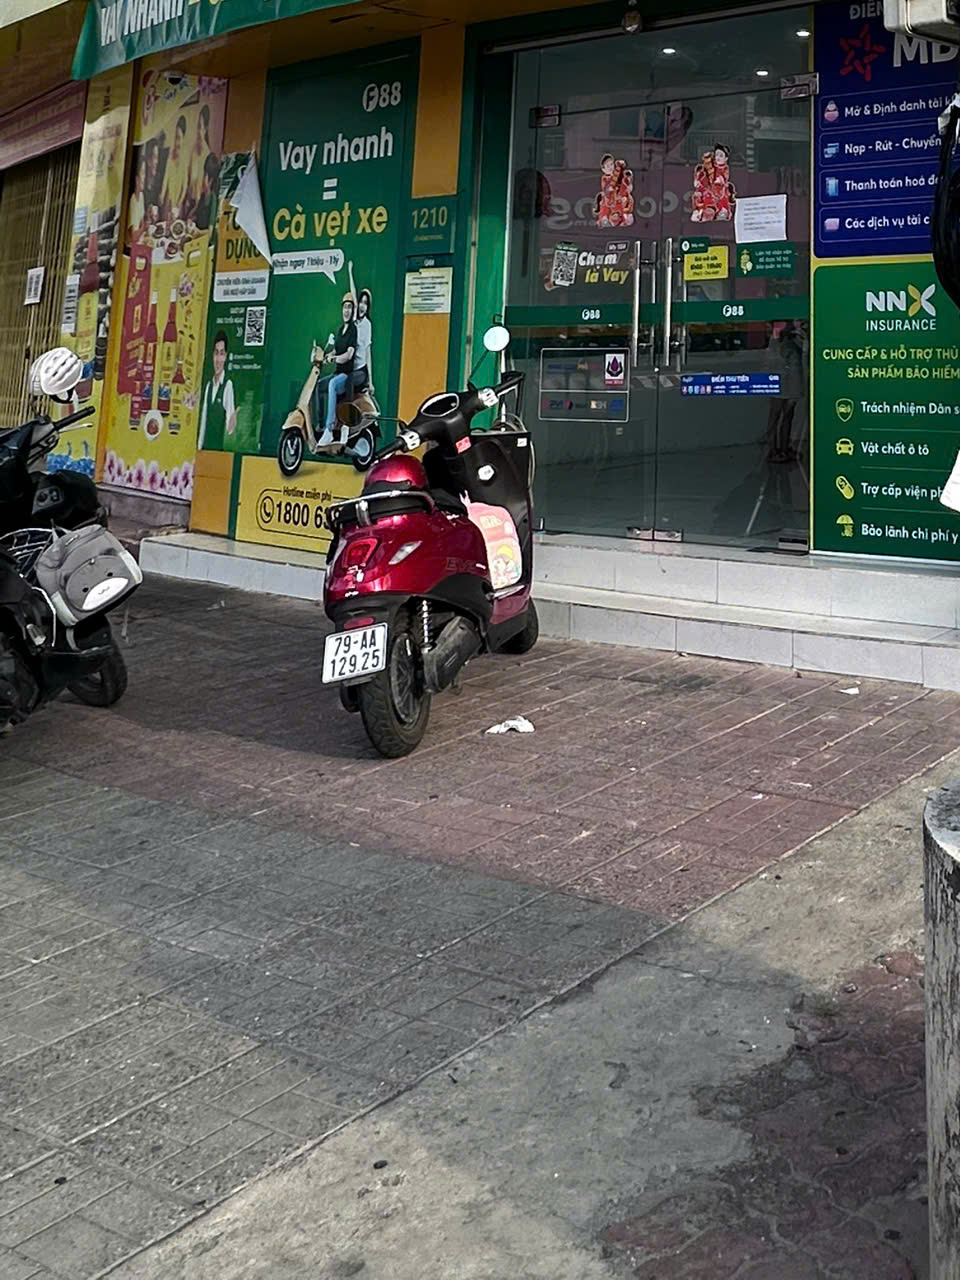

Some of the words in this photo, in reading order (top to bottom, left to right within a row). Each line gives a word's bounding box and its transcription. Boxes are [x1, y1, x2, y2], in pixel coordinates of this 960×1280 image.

[362, 81, 402, 112] F88
[844, 105, 862, 118] Mở
[873, 102, 897, 117] Định
[899, 100, 925, 112] danh
[928, 97, 943, 109] tài
[279, 141, 317, 175] Vay
[322, 126, 394, 166] nhanh
[844, 144, 866, 157] Nạp
[875, 140, 893, 152] Rút
[845, 179, 877, 191] Thanh
[879, 177, 903, 189] toán
[273, 203, 306, 241] Cà
[313, 201, 350, 246] vẹt
[356, 205, 389, 234] xe
[411, 206, 448, 229] 1210
[845, 215, 866, 229] Các
[867, 215, 890, 231] dịch
[892, 217, 905, 229] vụ
[907, 213, 922, 226] tài
[579, 252, 617, 270] Chạm
[603, 267, 629, 285] Vay
[866, 318, 937, 332] INSURANCE
[822, 348, 854, 361] CUNG
[856, 344, 878, 360] CẤP
[880, 349, 888, 360] &
[910, 348, 934, 363] TRỢ
[936, 345, 959, 360] THỦ
[847, 364, 869, 379] SẢN
[872, 364, 903, 379] PHẨM
[905, 364, 930, 379] BẢO
[932, 364, 960, 379] HIỂM
[861, 401, 891, 414] Trách
[893, 401, 926, 417] nhiệm
[929, 402, 951, 415] Dân
[861, 441, 879, 456] Vật
[881, 441, 906, 455] chất
[908, 443, 915, 455] ô
[918, 444, 929, 456] tô
[283, 485, 304, 499] Hotline
[861, 482, 880, 498] Trợ
[882, 482, 902, 499] cấp
[904, 485, 927, 500] viện
[276, 501, 310, 527] 1800
[861, 523, 882, 537] Bảo
[885, 525, 909, 539] lãnh
[911, 527, 929, 540] chi
[931, 528, 950, 544] phí
[952, 532, 958, 545] y
[333, 632, 378, 654] 79-AA
[330, 647, 381, 678] 129.25
